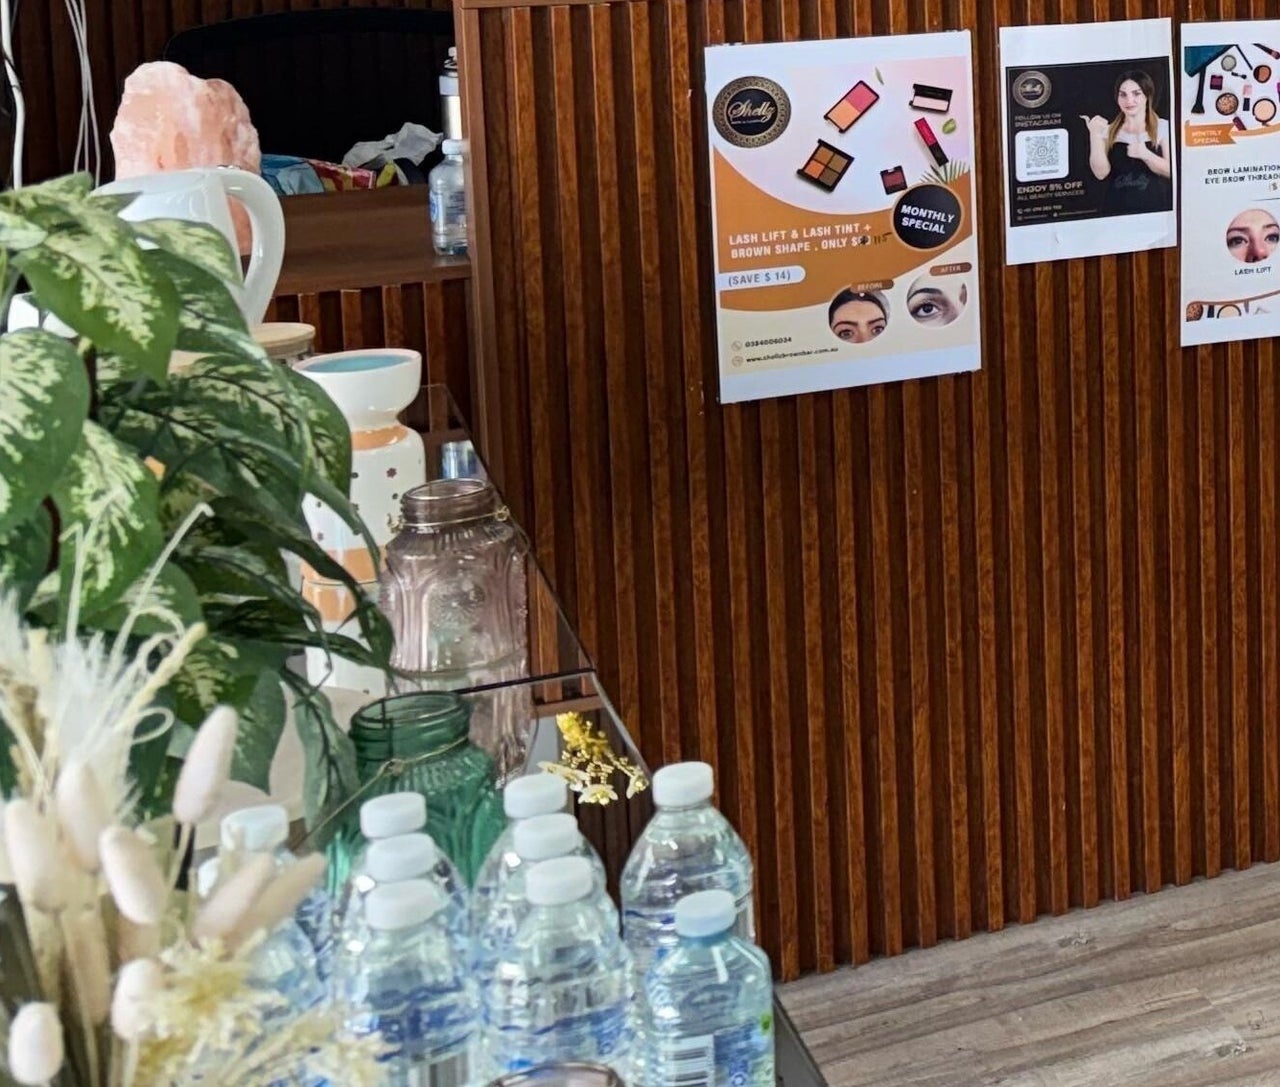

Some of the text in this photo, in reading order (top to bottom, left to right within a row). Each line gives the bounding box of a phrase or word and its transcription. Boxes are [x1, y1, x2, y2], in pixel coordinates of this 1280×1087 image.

[1015, 119, 1062, 127] INSTAGRAM
[1208, 168, 1231, 176] BROW
[1017, 184, 1047, 194] ENJOY
[1064, 180, 1083, 190] OFF
[1205, 176, 1220, 185] EYE
[1222, 175, 1246, 184] BROW
[900, 205, 956, 223] MONTHLY
[901, 217, 946, 235] SPECIAL
[729, 223, 872, 246] LASH LIFT & LASH TINT +
[731, 245, 770, 259] BROWN
[775, 242, 811, 255] SHAPE
[821, 238, 847, 250] ONLY
[728, 269, 791, 286] (SAVE $ 14)
[1234, 266, 1271, 276] LASH LIFT
